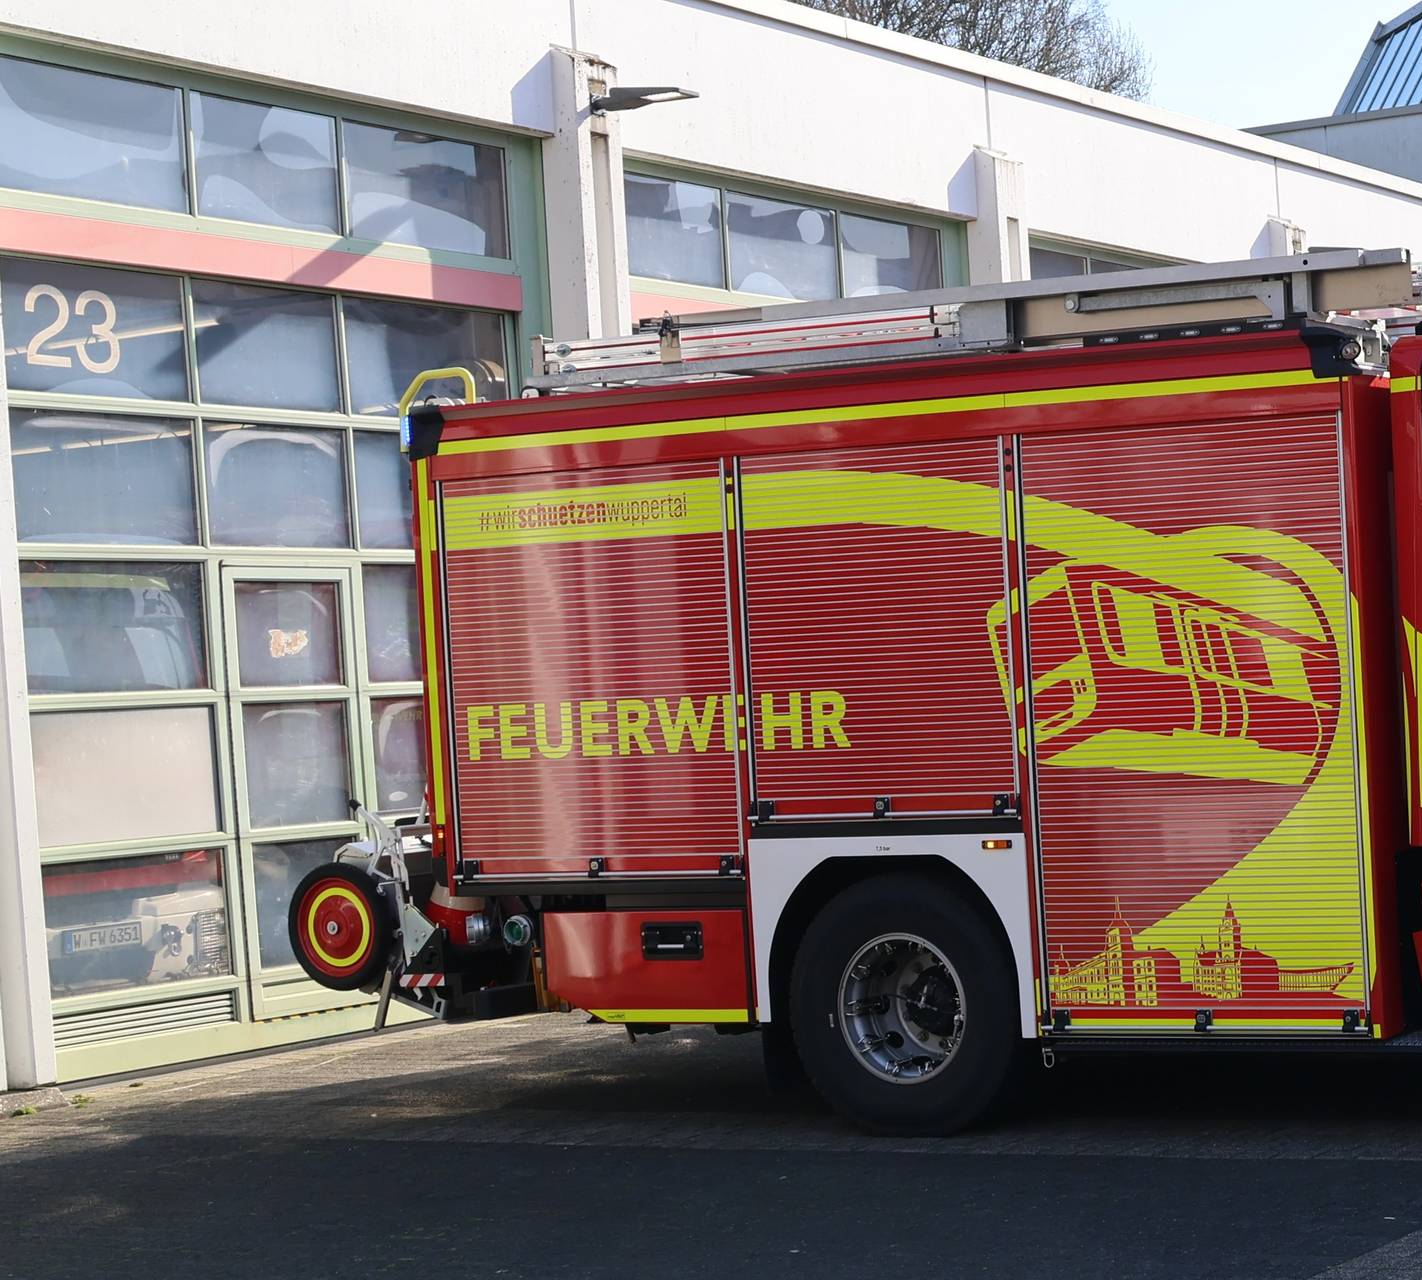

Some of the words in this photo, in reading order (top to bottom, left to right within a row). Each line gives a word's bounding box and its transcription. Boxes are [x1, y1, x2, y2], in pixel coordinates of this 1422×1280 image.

[25, 284, 120, 374] 23
[479, 491, 688, 532] #wirschuetzenwuppertal
[466, 690, 852, 761] FEUERWEHR
[109, 926, 140, 944] 6351
